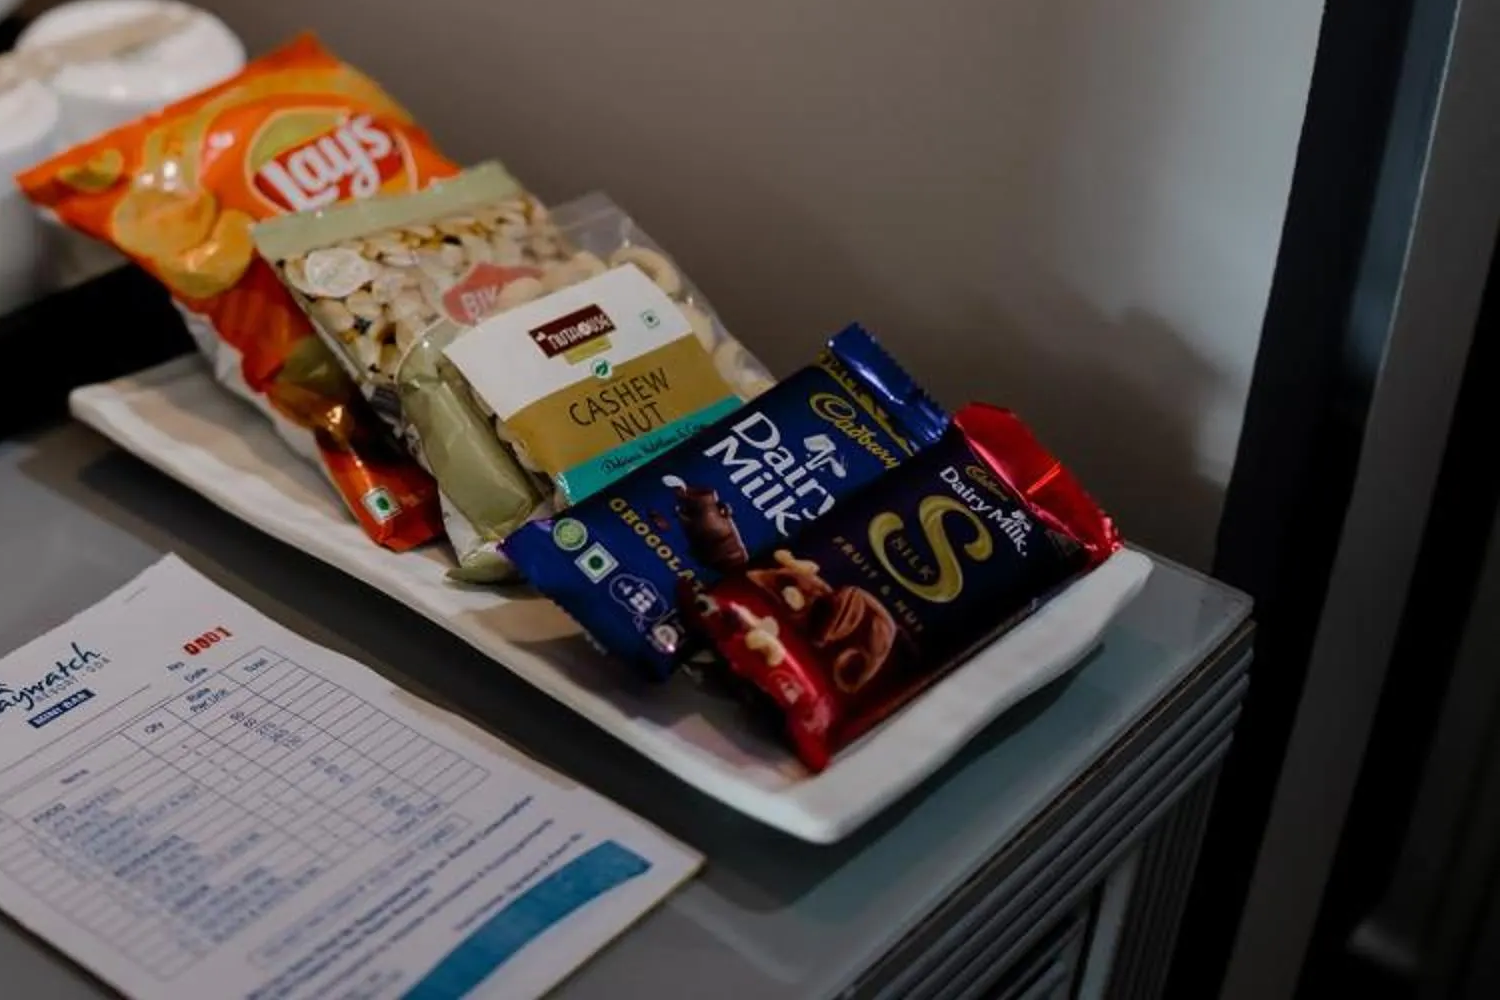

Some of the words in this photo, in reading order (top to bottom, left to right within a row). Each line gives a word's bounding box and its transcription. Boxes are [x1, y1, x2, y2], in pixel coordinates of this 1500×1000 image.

[569, 367, 670, 427] CASHEW
[611, 402, 667, 441] NUT
[809, 392, 901, 470] Cadbury
[702, 434, 802, 537] Milk
[729, 411, 836, 520] Dairy
[939, 464, 992, 511] Dairy
[988, 507, 1028, 557] Milk
